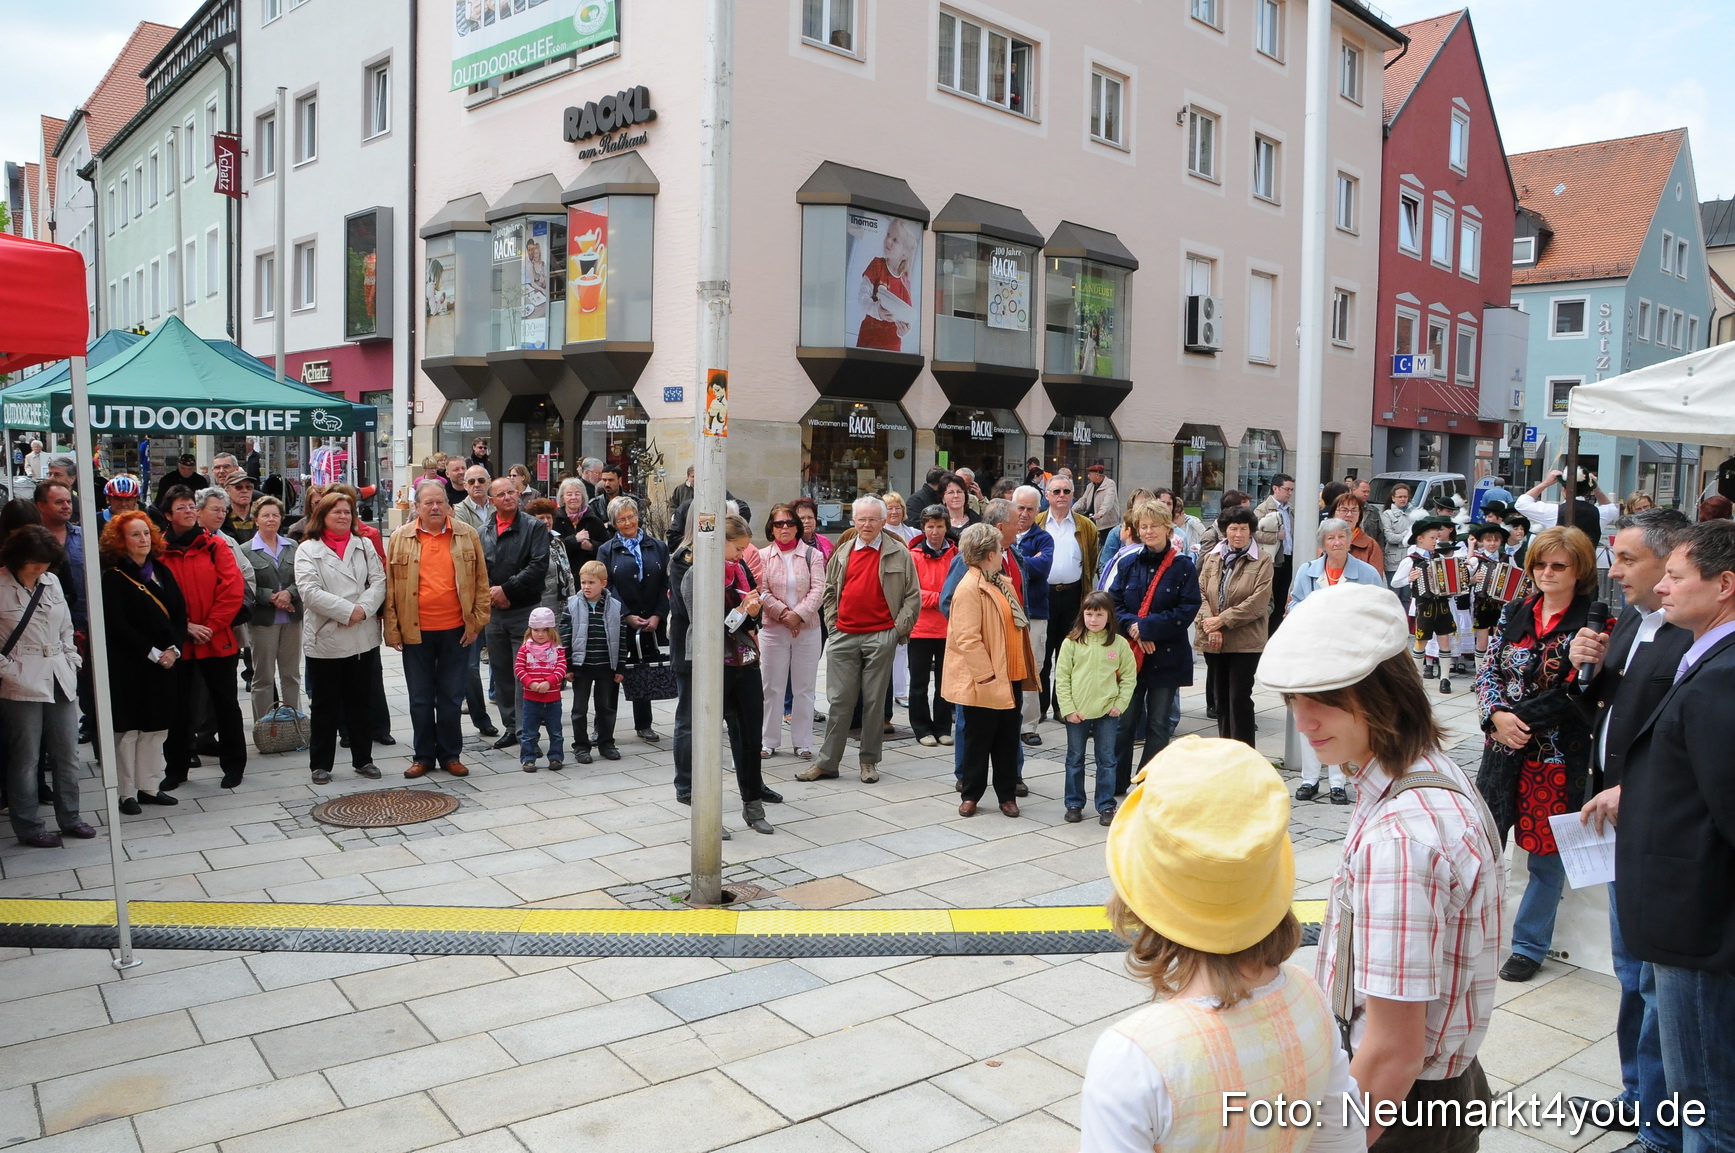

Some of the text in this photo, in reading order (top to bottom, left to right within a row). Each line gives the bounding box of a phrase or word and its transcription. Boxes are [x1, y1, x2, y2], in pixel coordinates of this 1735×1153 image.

[563, 85, 657, 143] RACKL
[578, 131, 647, 160] am Rathaus
[218, 145, 234, 191] Achatz
[849, 214, 878, 229] Thomas
[995, 247, 1006, 256] 100
[992, 256, 1018, 279] RACKL
[300, 360, 329, 383] Achatz
[3, 402, 42, 427] OUTDOORCHEF
[607, 414, 626, 430] RACKL
[808, 419, 841, 427] Willkommen
[849, 416, 876, 435] RACKL
[971, 420, 993, 437] RACKL
[1073, 427, 1092, 442] RACKL
[1524, 428, 1534, 441] P
